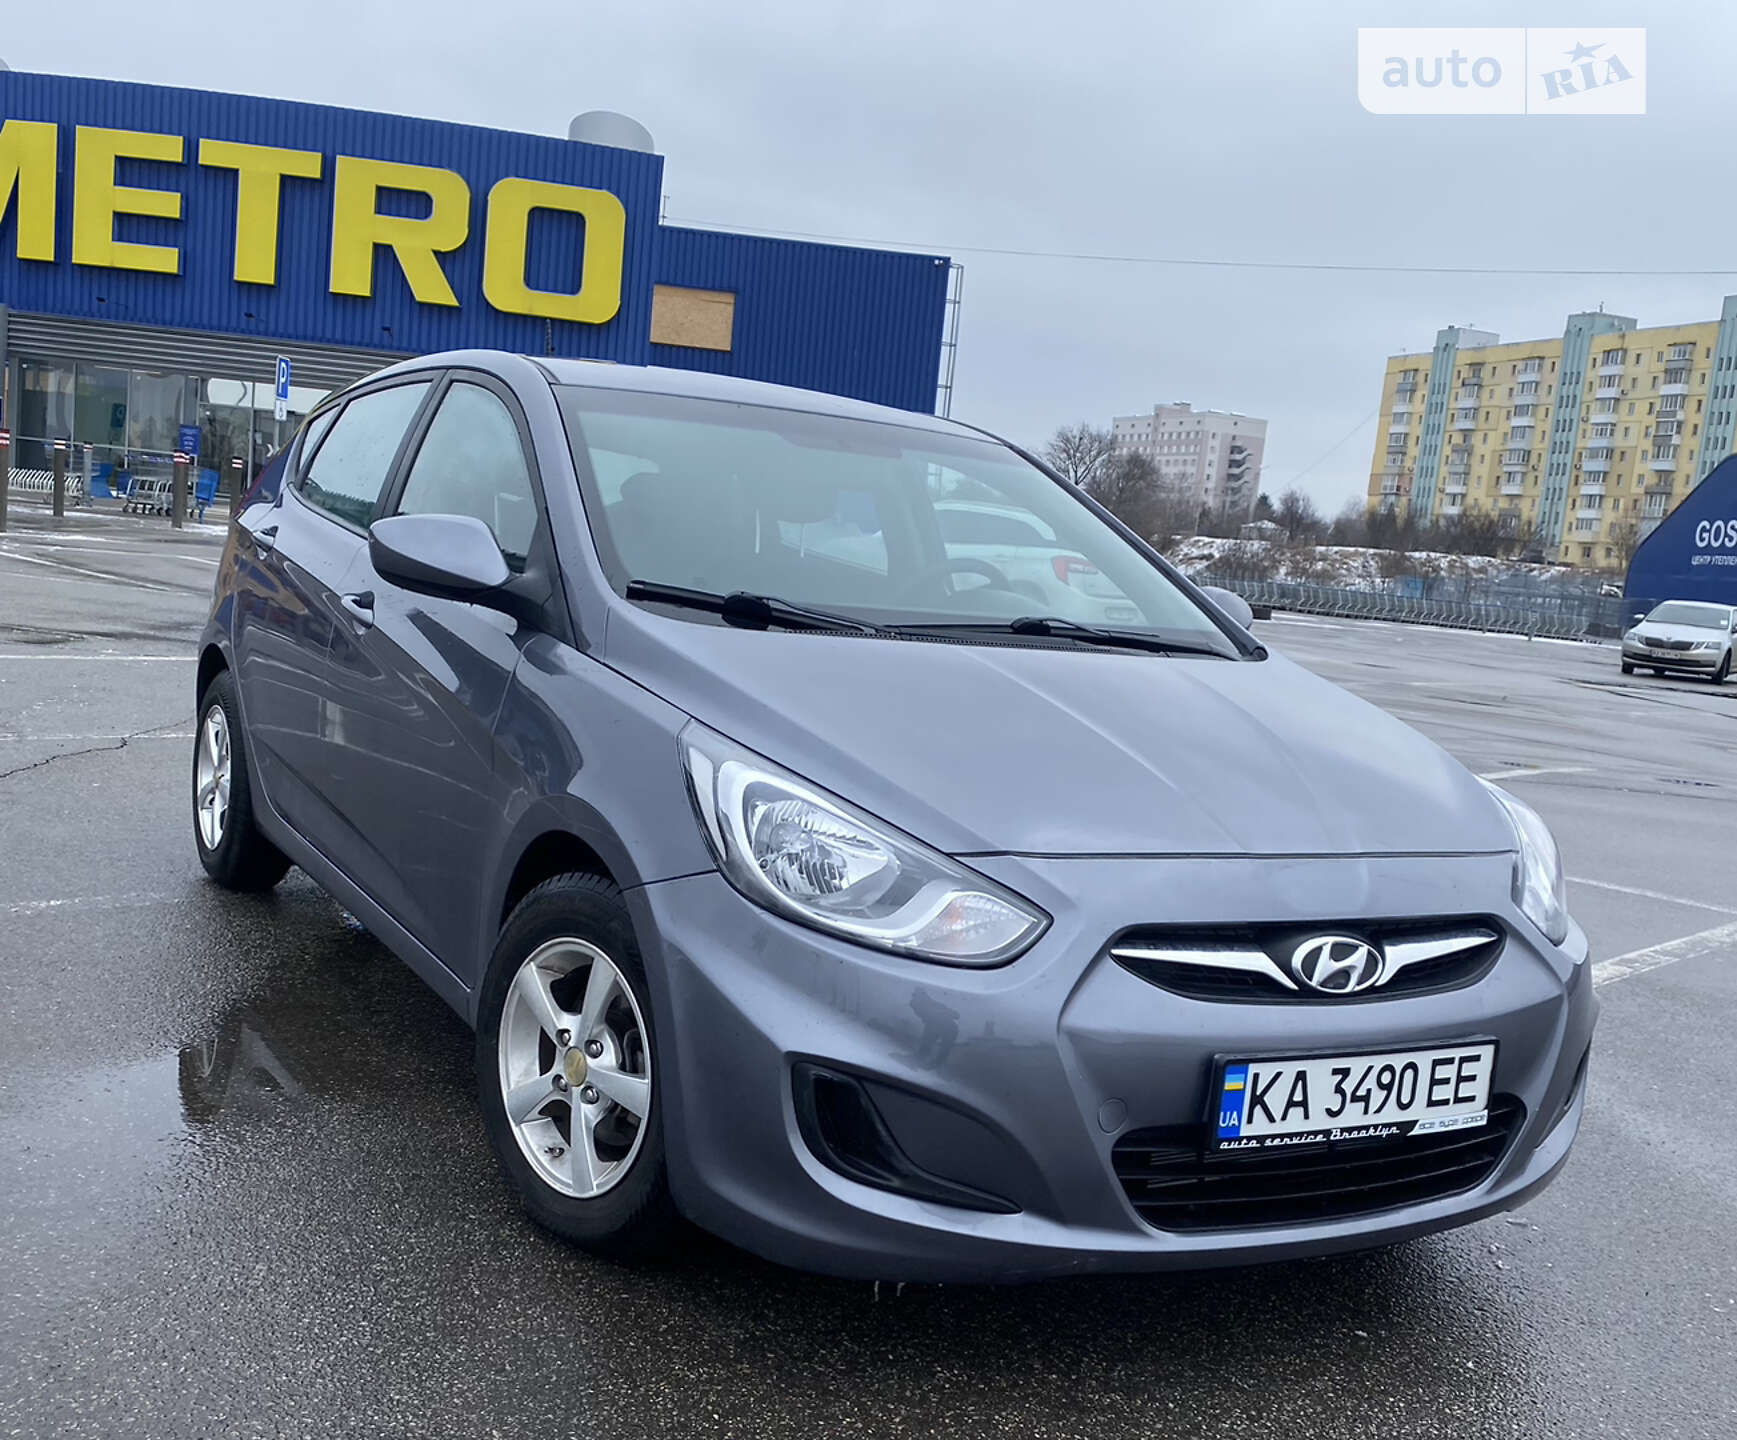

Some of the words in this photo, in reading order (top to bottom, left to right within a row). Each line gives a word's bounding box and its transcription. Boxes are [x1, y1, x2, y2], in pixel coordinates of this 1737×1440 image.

[1246, 1070, 1310, 1125] KA
[1324, 1061, 1419, 1118] 3490
[1426, 1053, 1483, 1108] EE
[1219, 1111, 1239, 1128] UA
[1219, 1138, 1261, 1149] auto
[1263, 1132, 1327, 1147] service
[1329, 1124, 1400, 1141] Brooklyn
